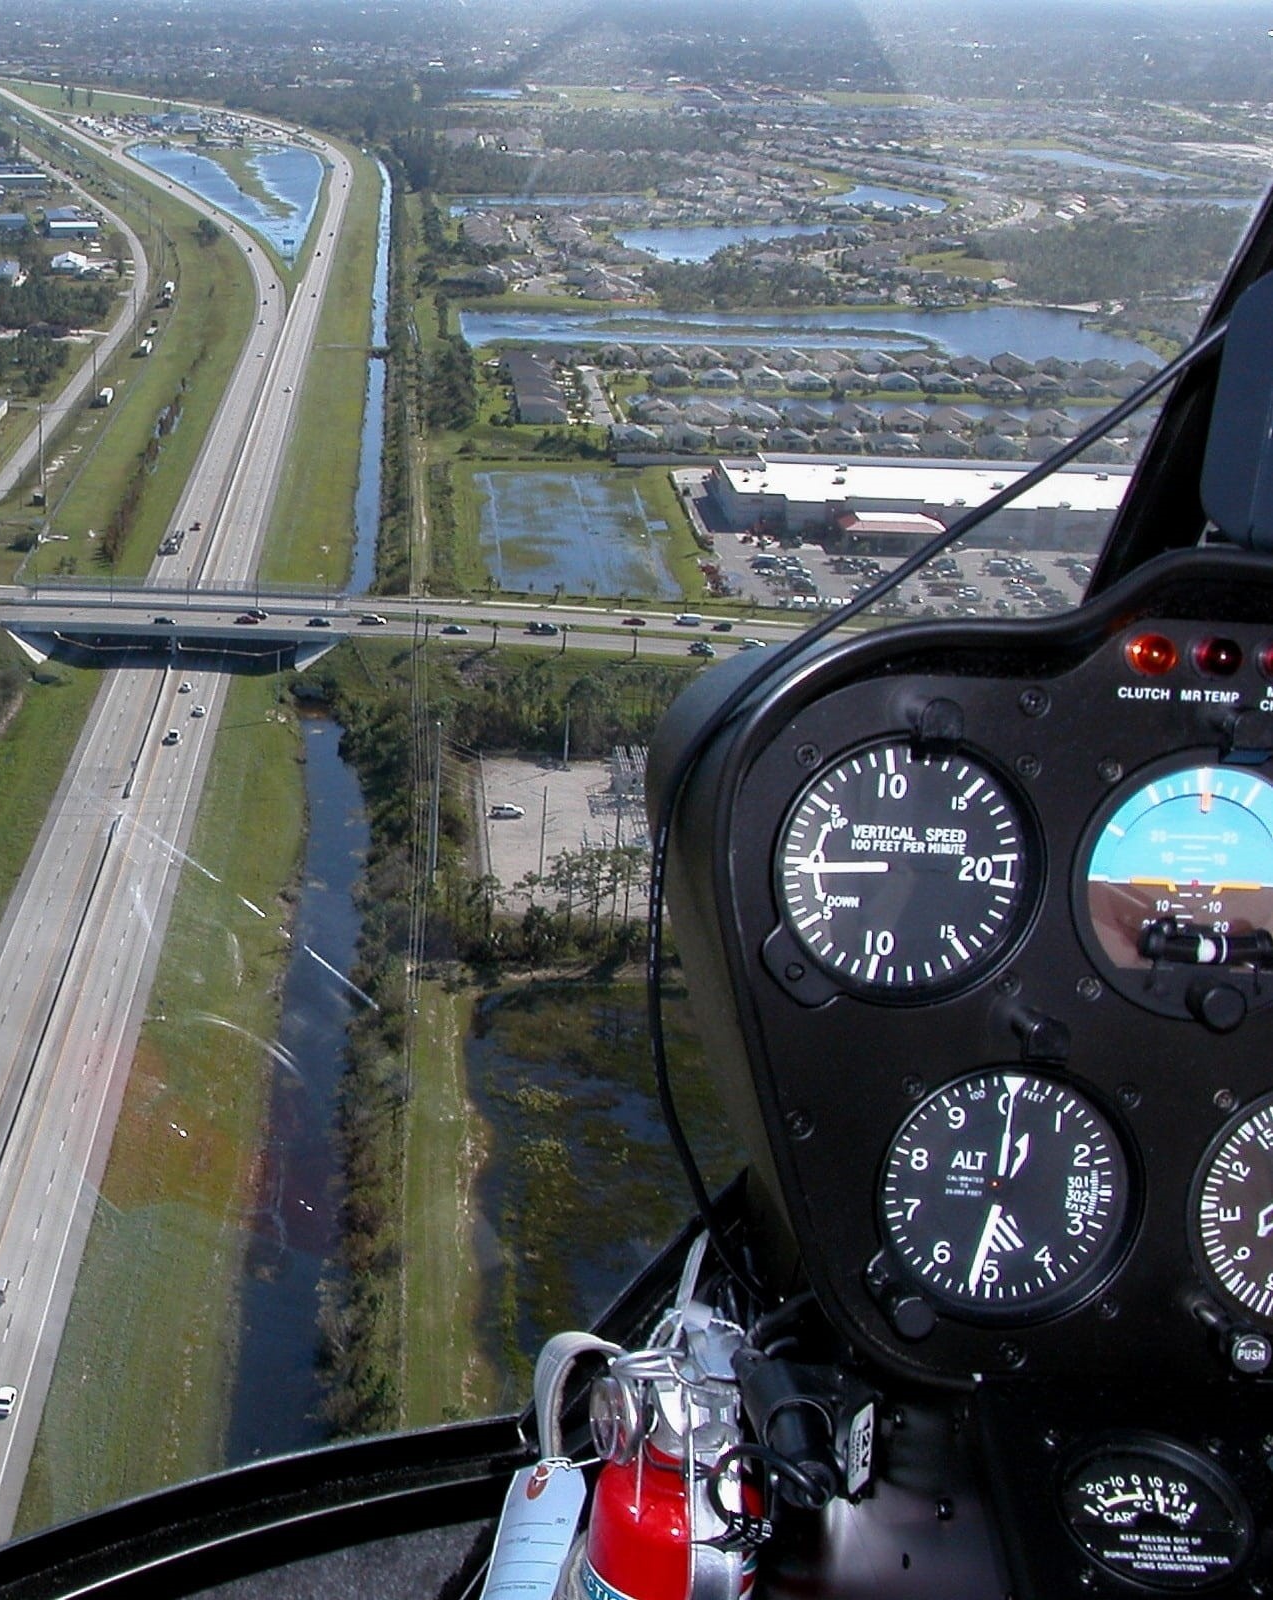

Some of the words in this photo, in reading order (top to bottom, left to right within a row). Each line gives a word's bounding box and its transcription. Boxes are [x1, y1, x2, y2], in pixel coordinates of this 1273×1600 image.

[1117, 686, 1171, 700] CLUTCH
[1180, 689, 1202, 702] MR
[1203, 690, 1240, 703] TEMP
[877, 773, 907, 799] 10
[831, 804, 841, 818] 5
[951, 796, 968, 811] 15
[831, 817, 849, 829] UP
[852, 824, 917, 841] VERTICAL
[925, 827, 967, 843] SPEED
[851, 839, 871, 851] 100
[873, 840, 900, 853] FEET
[903, 841, 926, 854] PER
[927, 842, 967, 855] MINUTE
[958, 856, 993, 882] 20
[827, 895, 860, 908] DOWN
[1156, 900, 1170, 912] 10
[822, 906, 833, 920] 5
[940, 925, 957, 939] 15
[1213, 921, 1229, 934] 20
[865, 930, 895, 956] 10
[969, 1089, 986, 1101] 100
[1022, 1089, 1046, 1103] FEET
[948, 1106, 967, 1130] 9
[1055, 1110, 1062, 1133] 1
[910, 1148, 929, 1171] 8
[951, 1150, 988, 1171] ALT
[1073, 1144, 1091, 1168] 2
[1228, 1161, 1251, 1183] 12
[903, 1198, 921, 1221] 7
[1219, 1206, 1240, 1222] E
[1067, 1212, 1085, 1236] 3
[933, 1241, 951, 1264] 6
[1034, 1245, 1053, 1268] 4
[982, 1259, 999, 1283] 5
[1237, 1349, 1265, 1361] PUSH
[861, 1420, 872, 1468] 12V
[1079, 1483, 1105, 1494] -20
[1103, 1476, 1125, 1488] -10
[1130, 1474, 1141, 1486] 0
[1148, 1476, 1164, 1488] 10
[1168, 1482, 1188, 1494] 20
[1119, 1533, 1140, 1542] KEEP
[1141, 1534, 1172, 1544] NEEDLE
[1173, 1536, 1189, 1545] OUT
[1138, 1543, 1171, 1553] YELLOW
[1103, 1550, 1135, 1560] DURING
[1136, 1551, 1175, 1561] POSSIBLE
[1176, 1554, 1230, 1564] CARBURETOR
[1157, 1562, 1207, 1573] CONDITIONS
